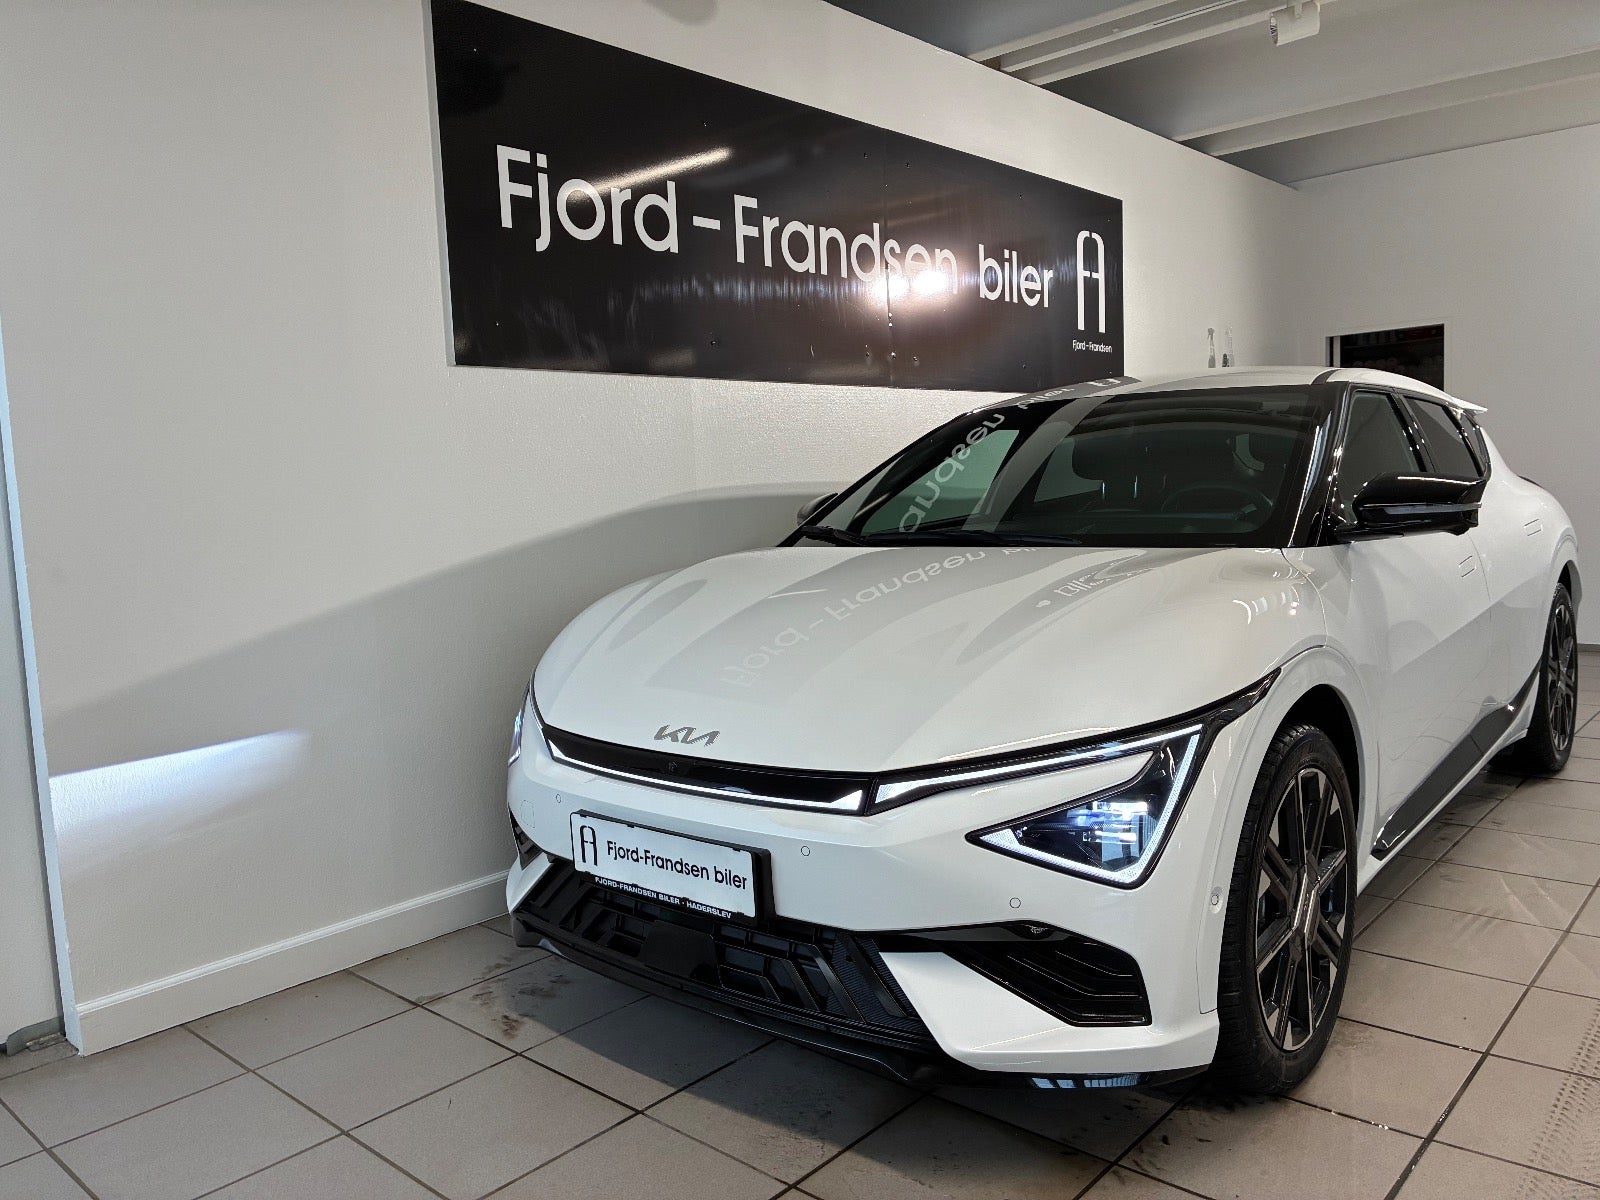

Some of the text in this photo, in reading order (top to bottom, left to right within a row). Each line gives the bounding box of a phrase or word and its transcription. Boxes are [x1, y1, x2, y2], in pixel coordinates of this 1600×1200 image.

[497, 144, 679, 254] Fjord
[734, 194, 958, 295] Frandsen
[978, 243, 1054, 308] biler
[653, 724, 720, 747] KIA
[607, 840, 709, 880] Fjord-Frandsen
[713, 866, 747, 890] biler
[594, 876, 732, 919] FJORD-FRANDSEN BILER HADERSLEV
